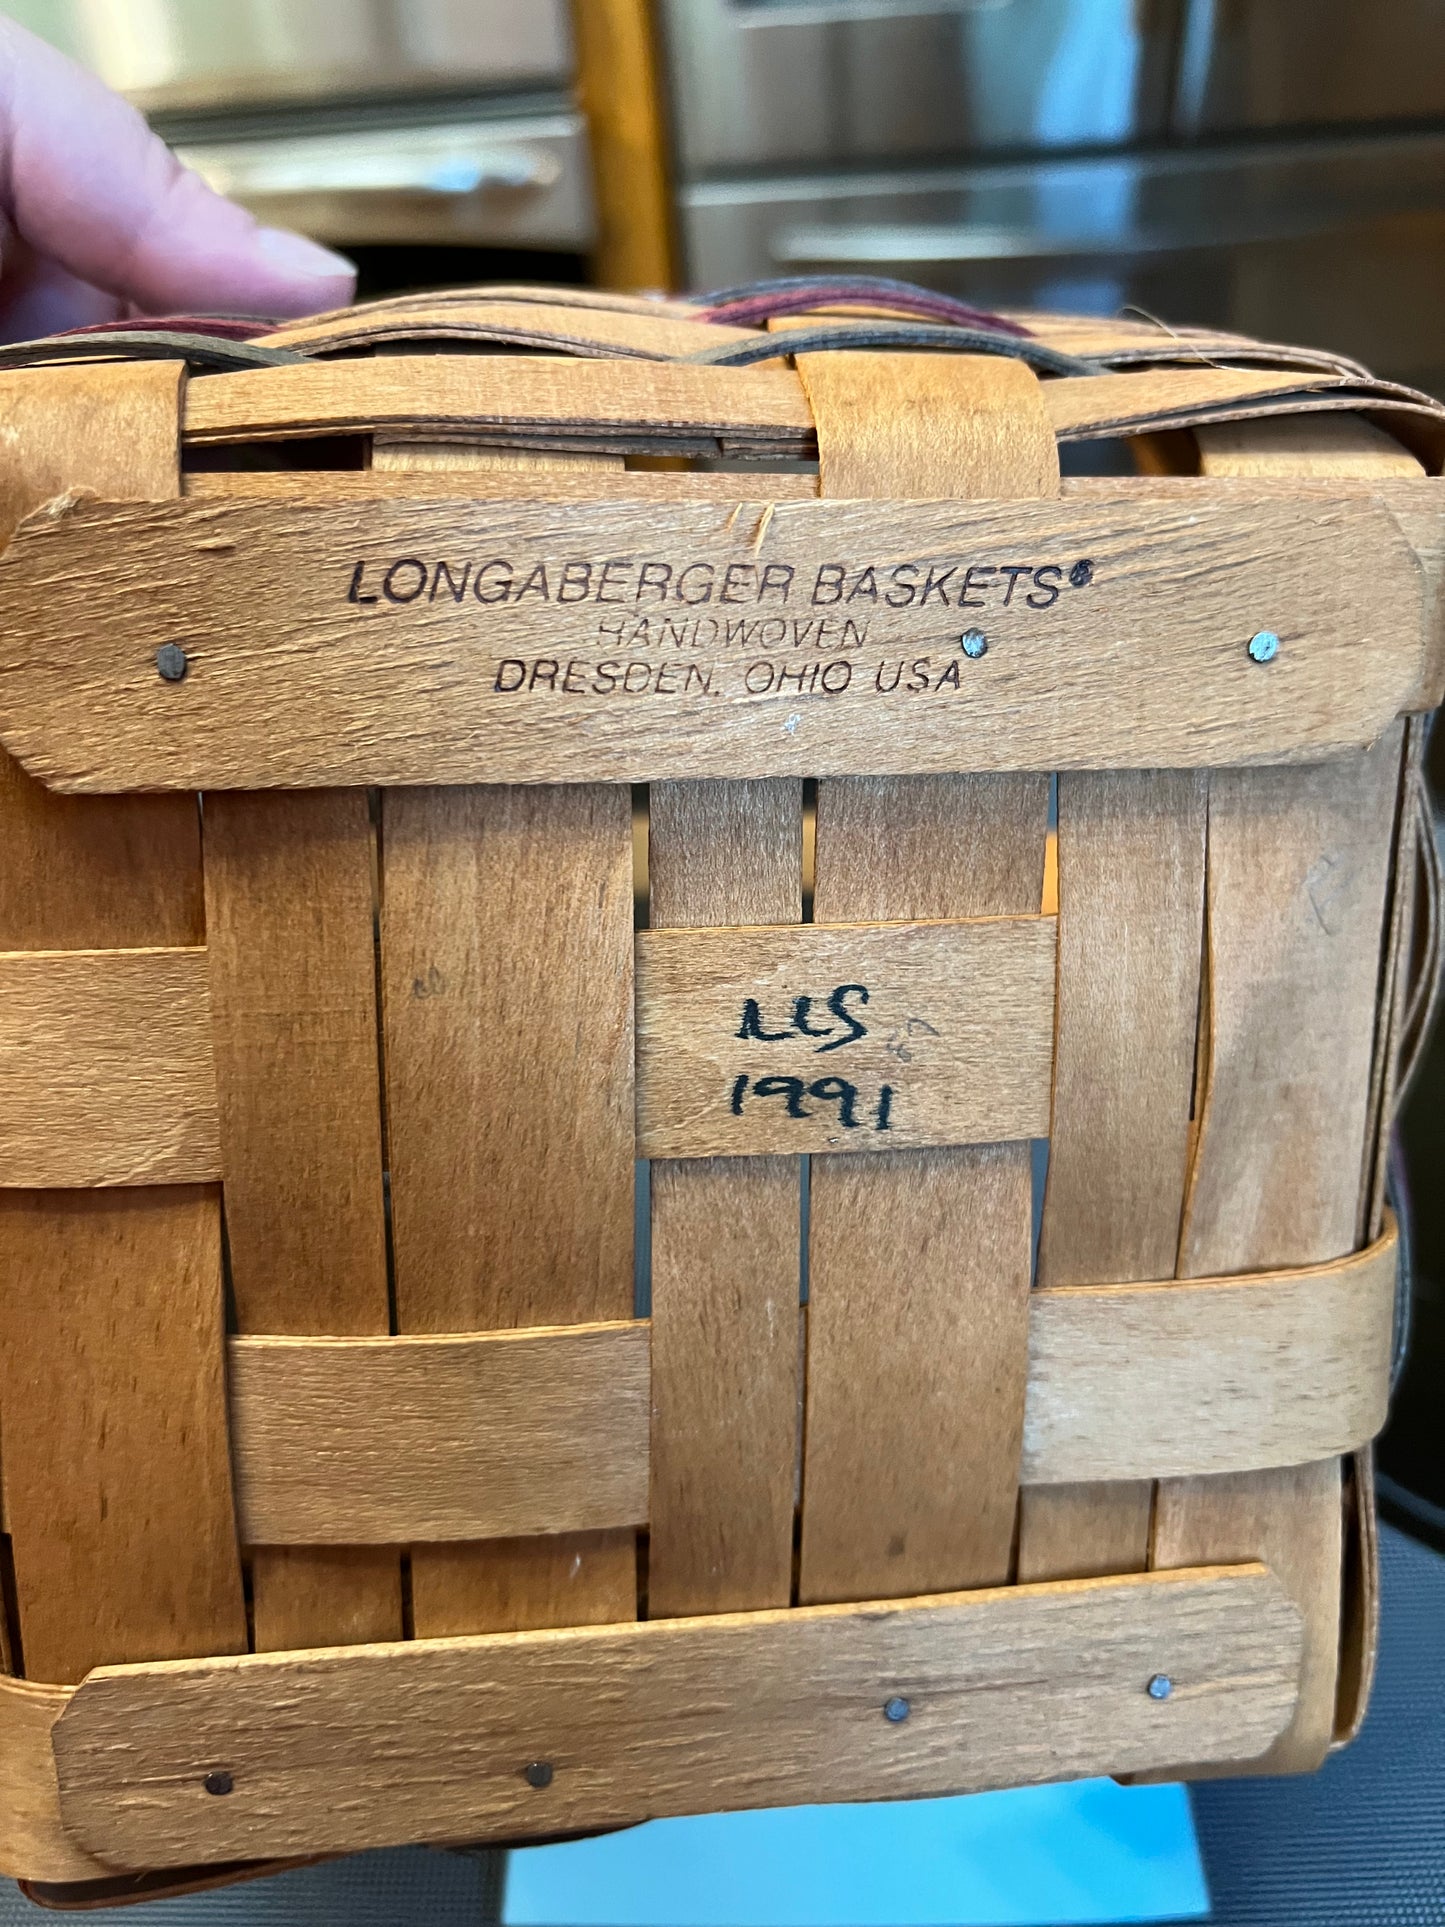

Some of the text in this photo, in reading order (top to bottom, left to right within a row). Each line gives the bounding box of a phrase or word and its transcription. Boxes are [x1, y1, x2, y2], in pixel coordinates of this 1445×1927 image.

[349, 558, 795, 604] LONGABERGER
[598, 617, 870, 649] HANDWOVEN
[744, 660, 852, 695] OHIO
[874, 657, 961, 694] USA
[730, 1074, 894, 1130] 1991
